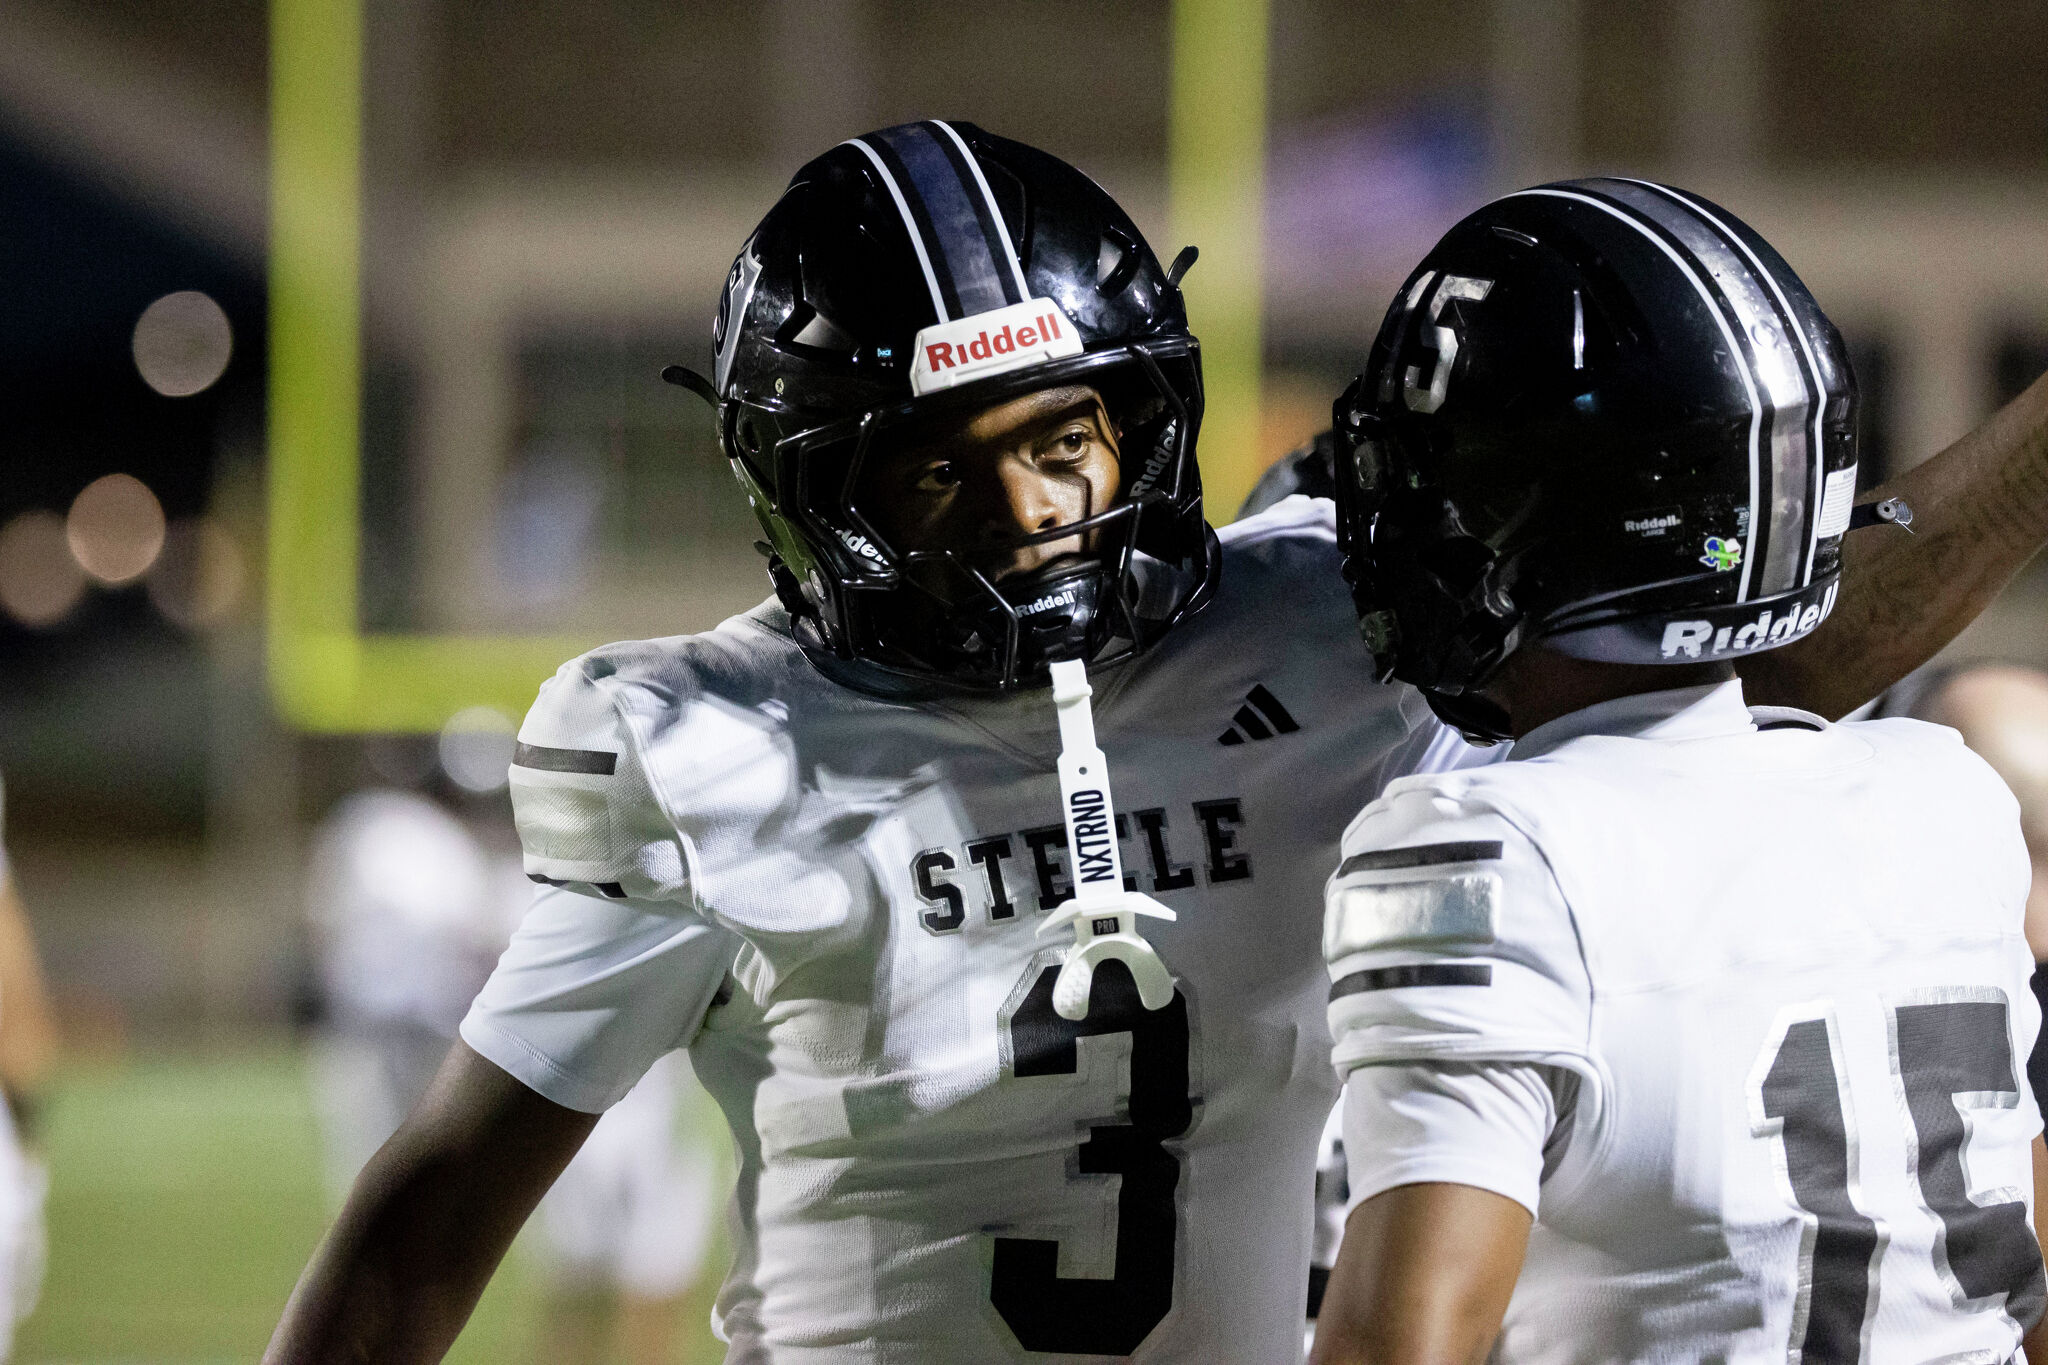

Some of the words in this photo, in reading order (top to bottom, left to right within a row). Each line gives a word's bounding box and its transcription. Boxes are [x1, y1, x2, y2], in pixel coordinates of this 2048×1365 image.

[925, 312, 1063, 373] Riddell
[1129, 418, 1177, 497] Ridde
[1624, 514, 1677, 532] Riddell
[1014, 590, 1075, 618] Riddell
[1660, 579, 1840, 660] Riddell
[909, 796, 1254, 937] STELE
[1070, 789, 1115, 884] NXTRND
[1096, 918, 1115, 934] PRO
[990, 946, 1194, 1357] 3
